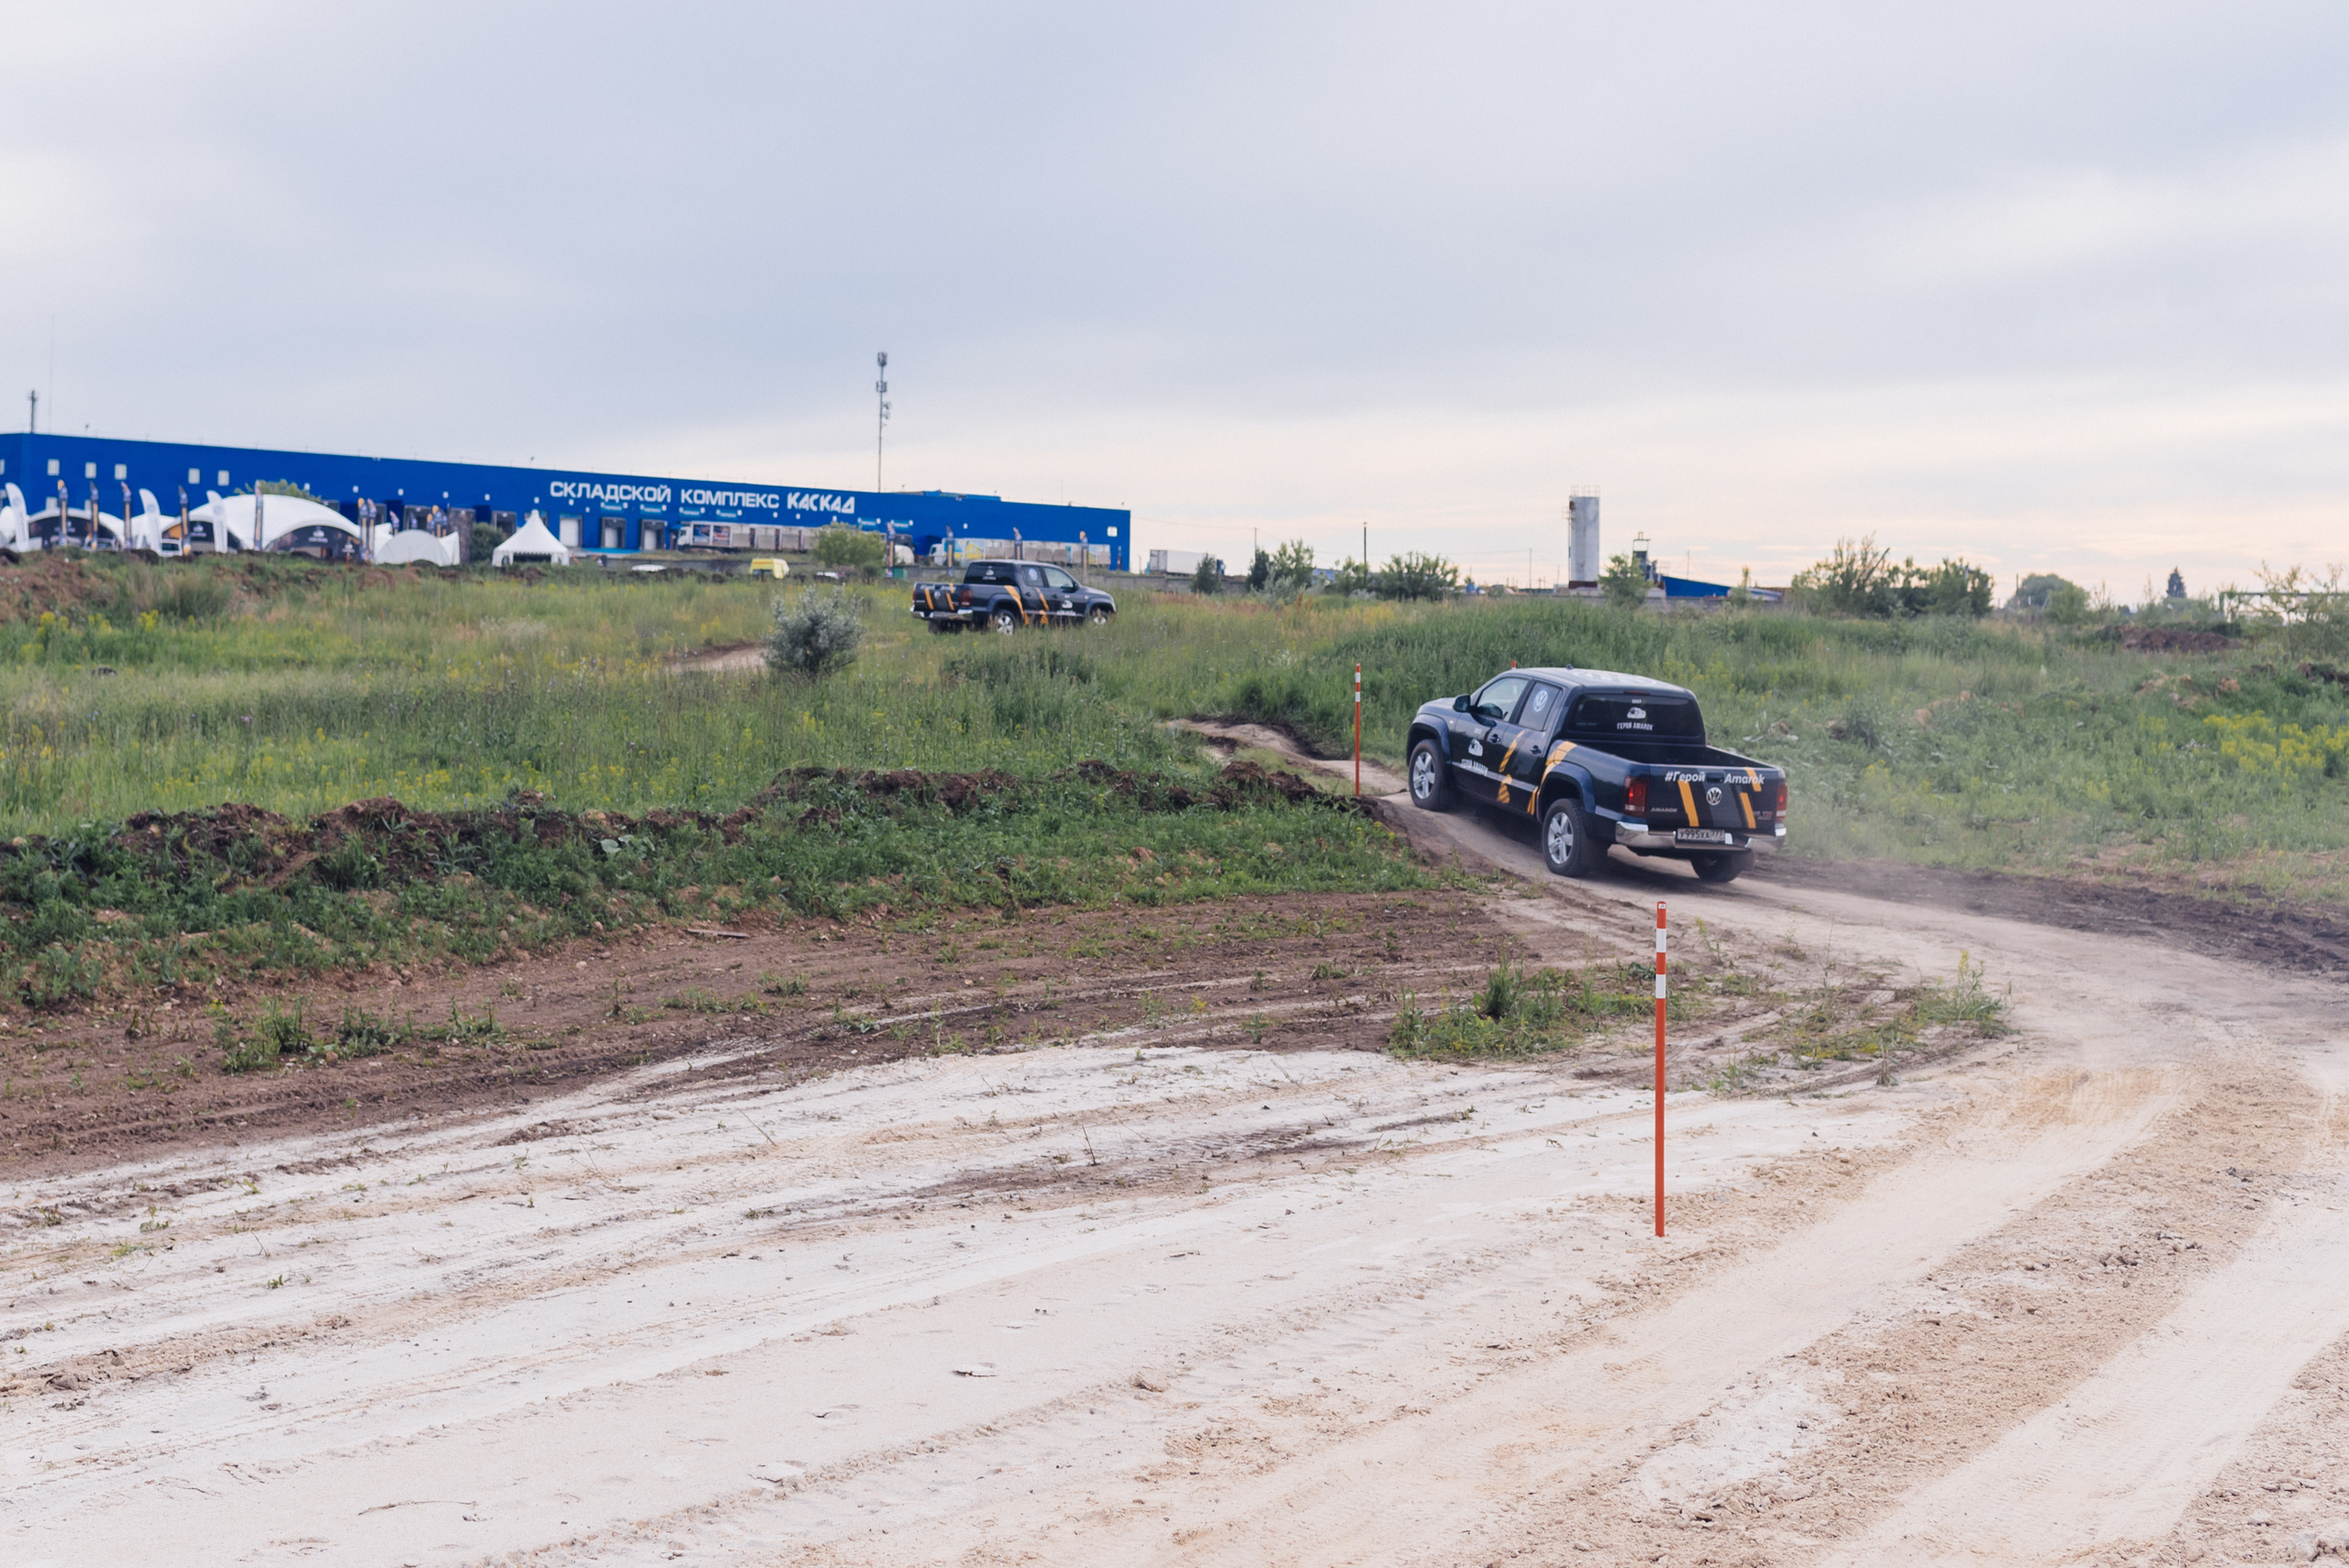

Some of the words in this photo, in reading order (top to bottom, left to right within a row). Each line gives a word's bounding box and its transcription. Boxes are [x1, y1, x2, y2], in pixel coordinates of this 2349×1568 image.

[550, 481, 672, 504] СКЛАДСКОЙ
[681, 488, 780, 509] КОМПЛЕКС
[786, 491, 856, 515] КАСКАД
[1664, 771, 1707, 784] #Герой
[1724, 773, 1765, 784] Amarok
